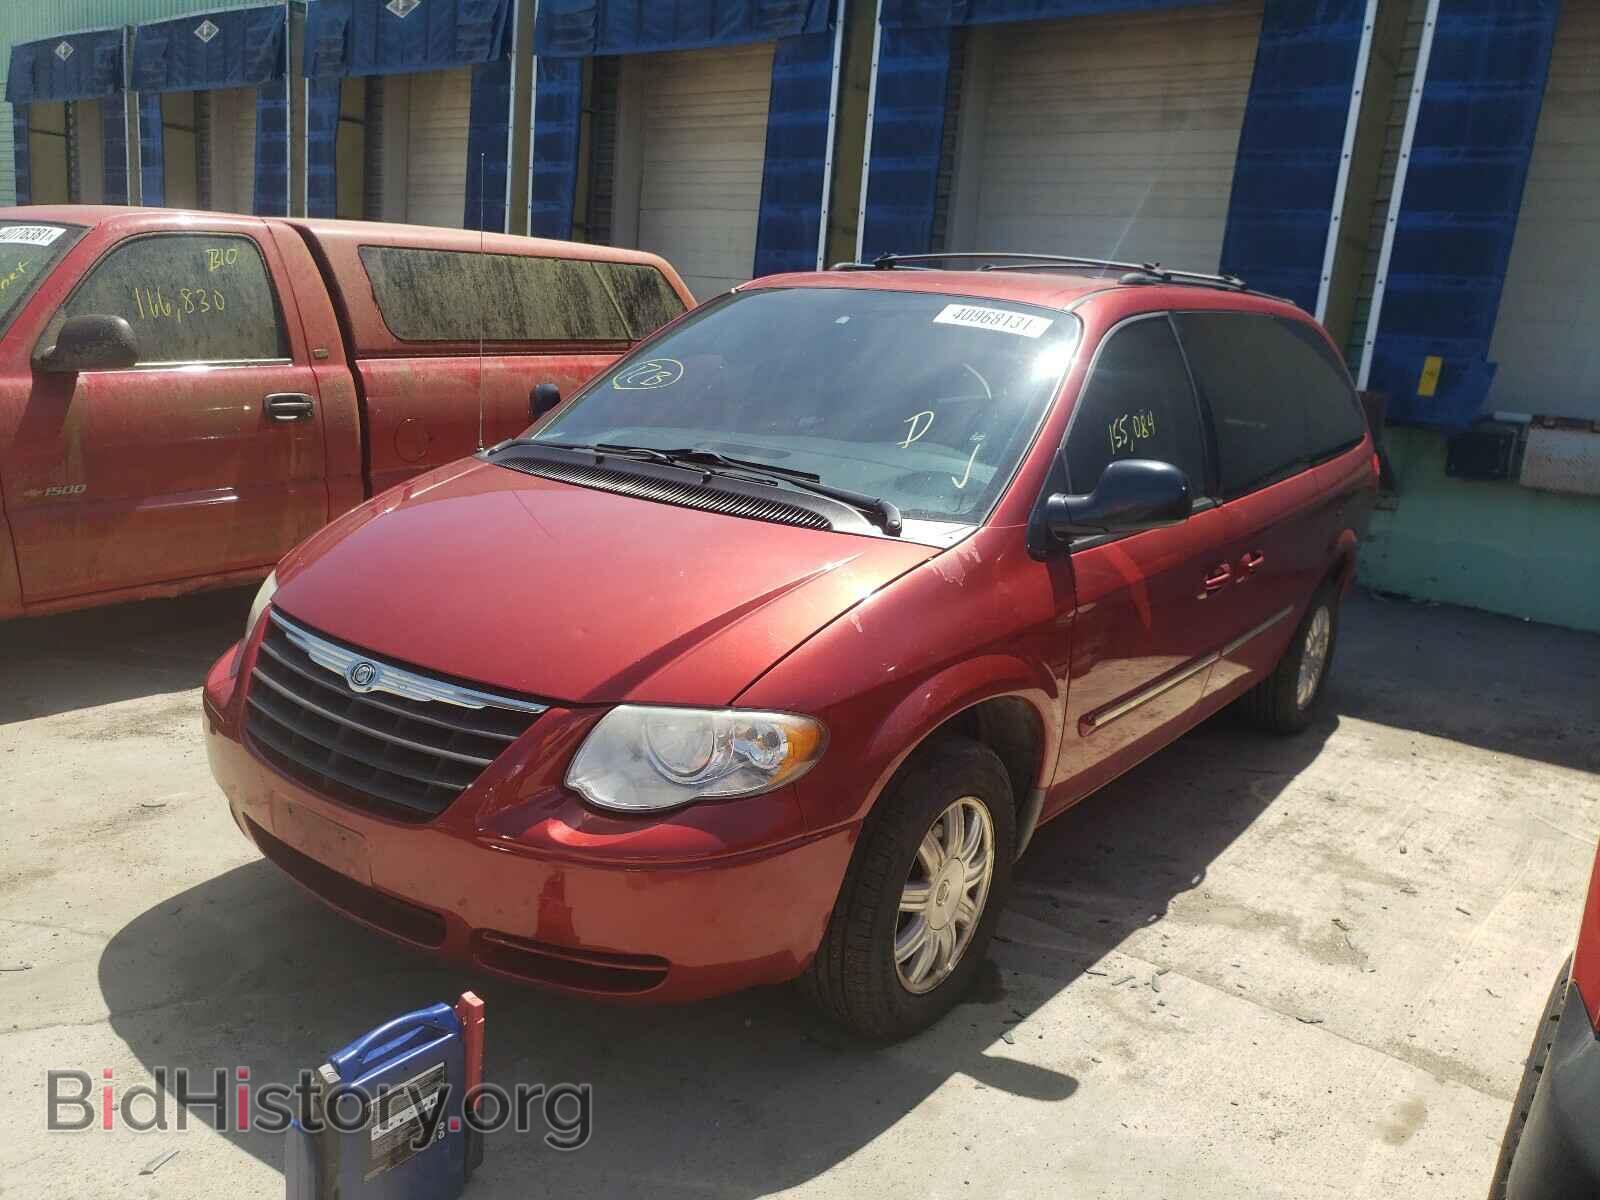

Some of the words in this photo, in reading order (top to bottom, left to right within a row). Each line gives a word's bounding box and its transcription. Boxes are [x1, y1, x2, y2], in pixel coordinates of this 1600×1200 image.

[134, 287, 225, 323] 166,830
[952, 307, 1034, 331] 40968131
[1108, 409, 1156, 456] 155,084
[44, 484, 88, 497] 1500
